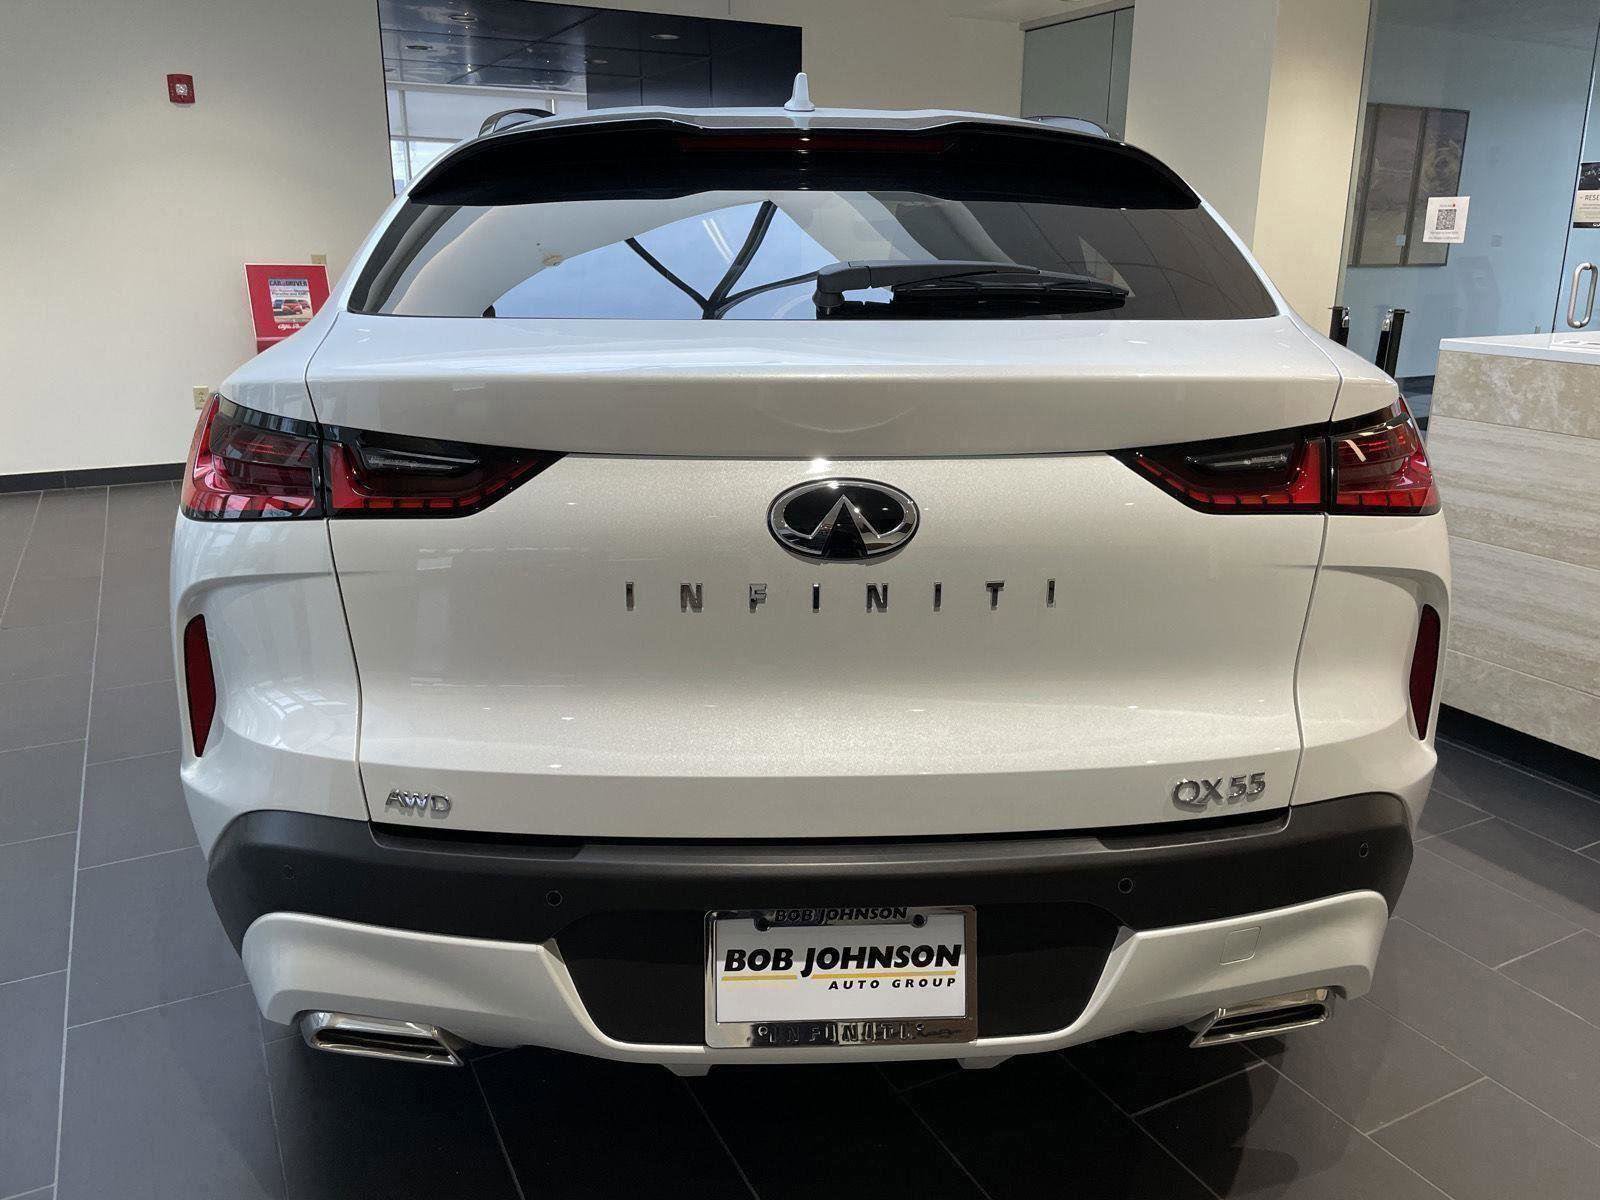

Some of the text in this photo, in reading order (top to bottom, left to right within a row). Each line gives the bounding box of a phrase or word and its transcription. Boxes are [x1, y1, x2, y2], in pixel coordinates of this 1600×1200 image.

[625, 579, 1057, 612] INFINITI
[385, 788, 452, 814] AWD
[774, 906, 908, 925] BOB JOHNSON
[724, 944, 962, 977] BOB JOHNSON
[828, 977, 957, 990] AUTO GROUP
